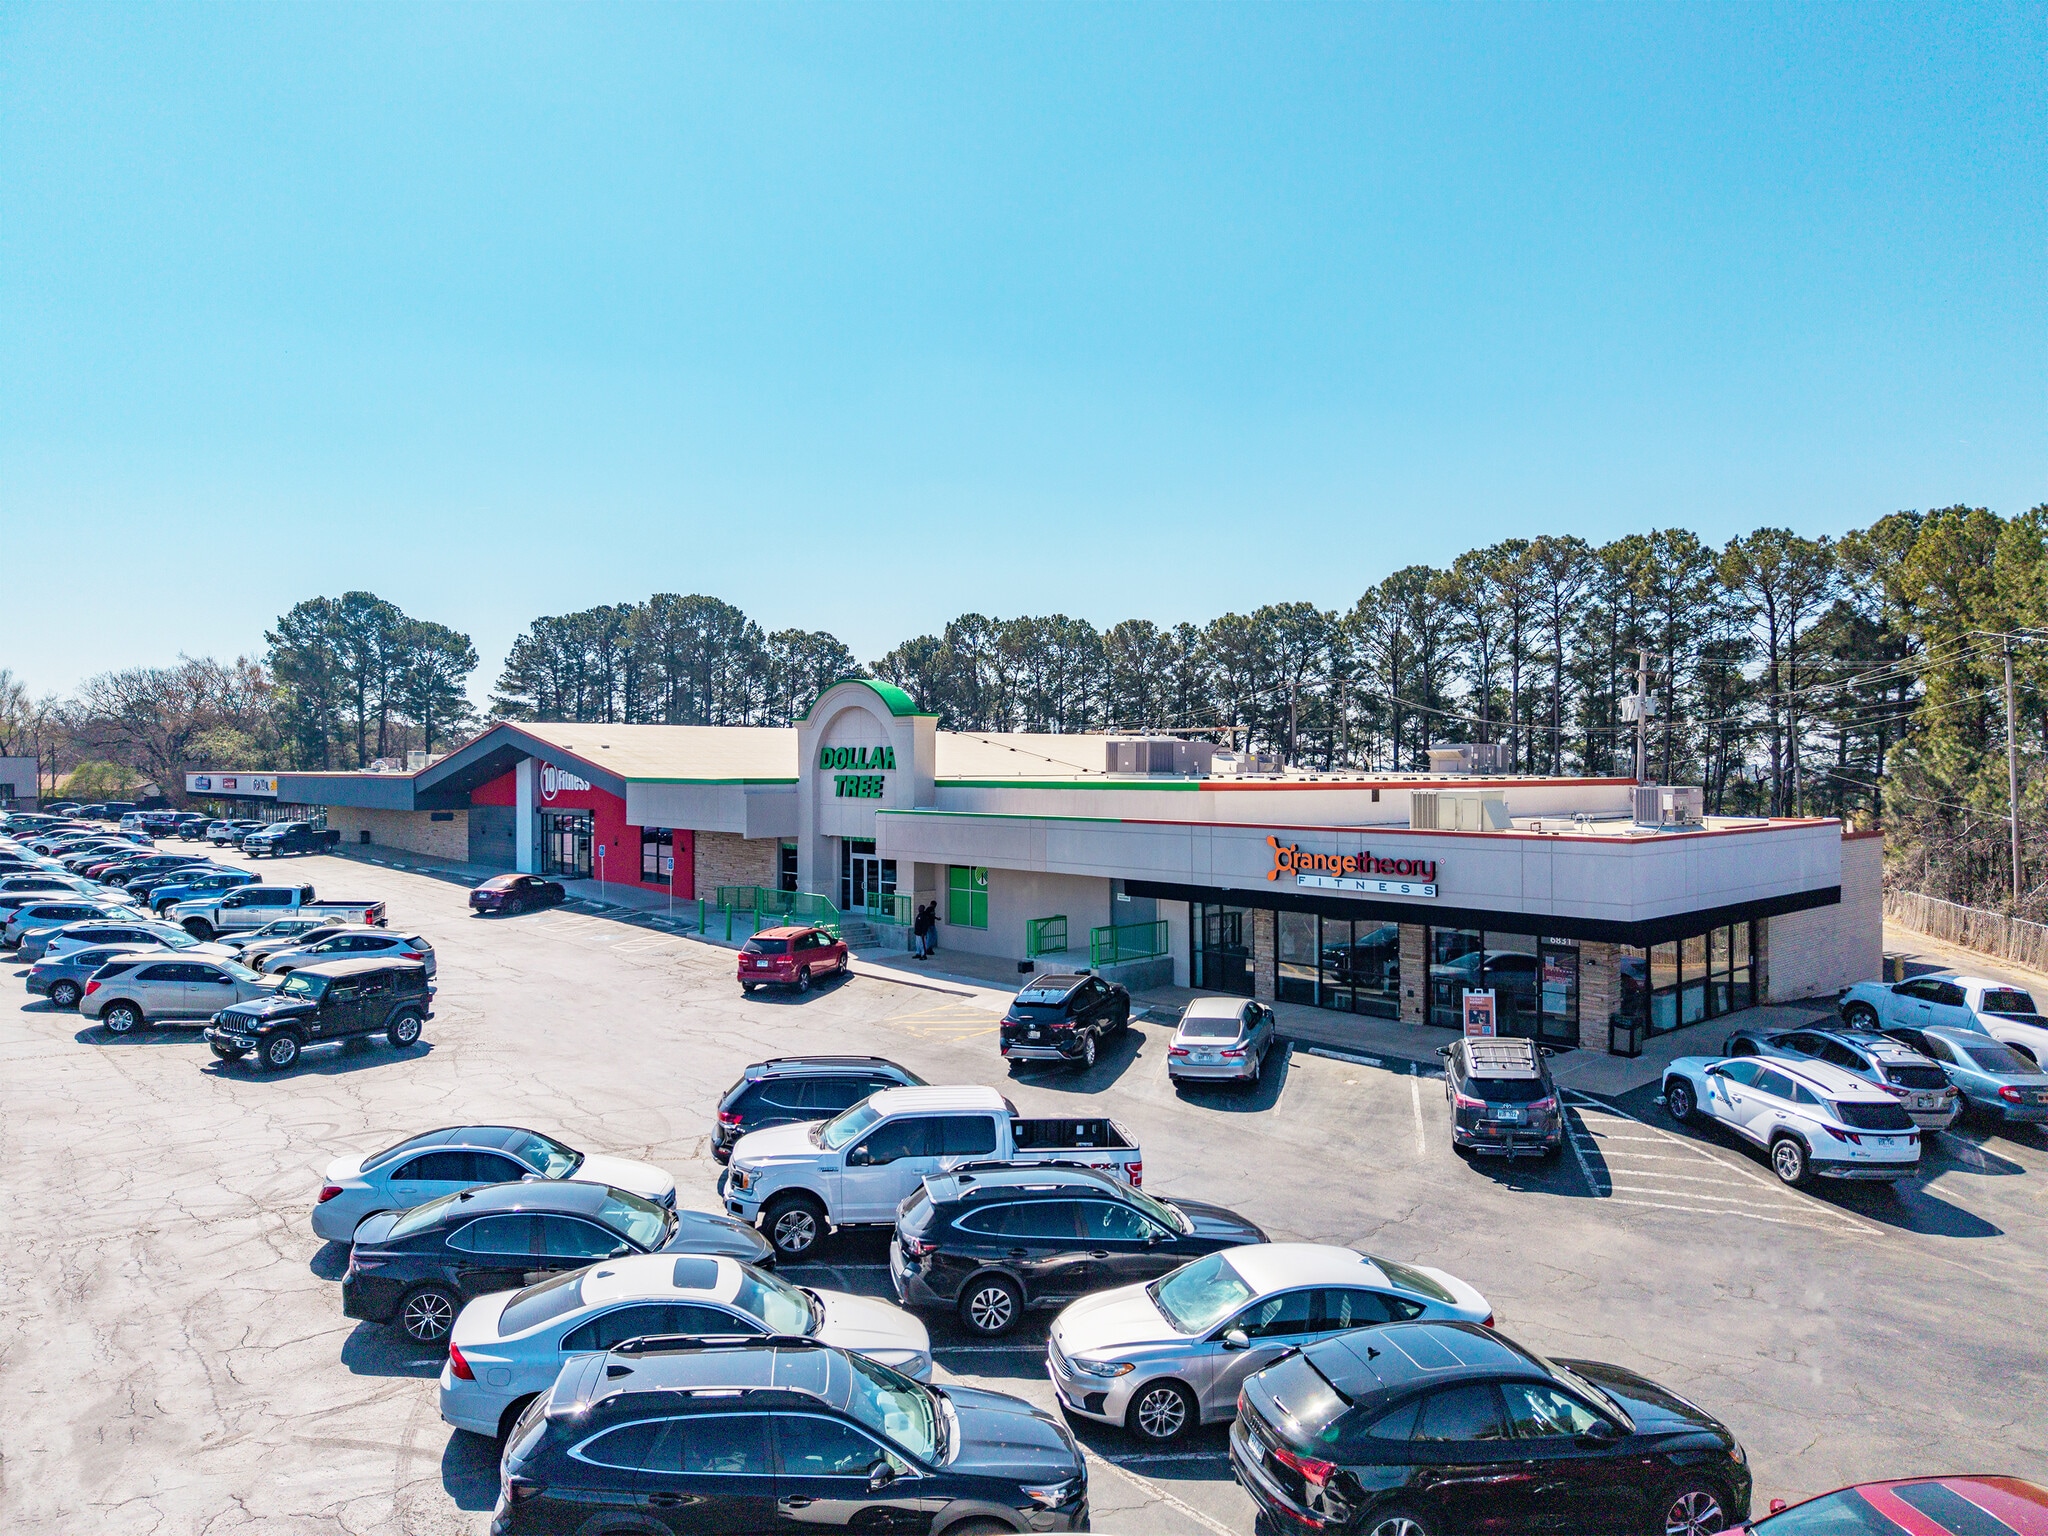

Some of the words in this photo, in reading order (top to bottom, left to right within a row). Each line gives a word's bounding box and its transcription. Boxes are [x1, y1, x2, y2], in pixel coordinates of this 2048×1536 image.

[820, 746, 896, 770] DOLLAR
[543, 767, 555, 793] 10
[834, 775, 884, 799] TREE
[1298, 876, 1433, 896] FITNESS
